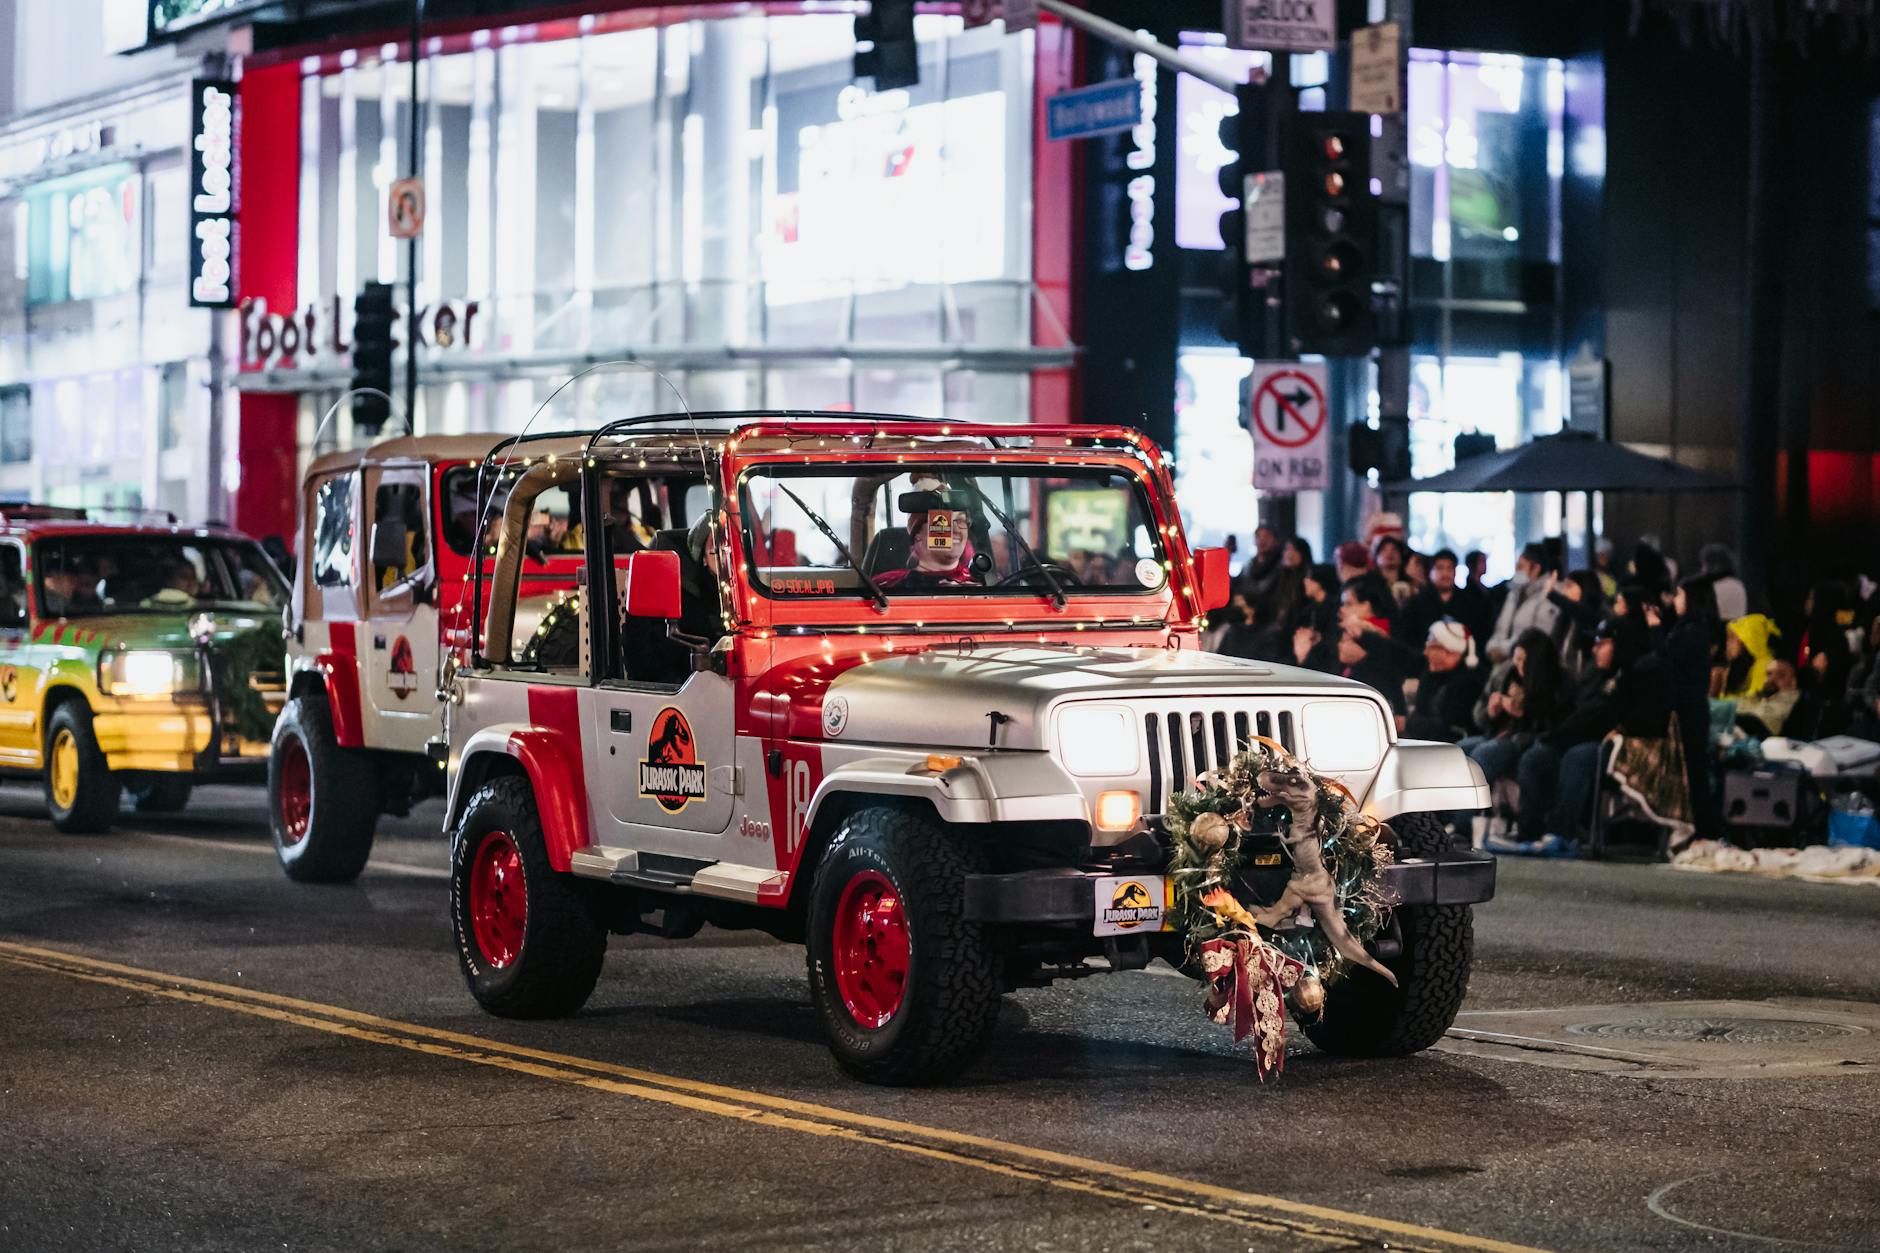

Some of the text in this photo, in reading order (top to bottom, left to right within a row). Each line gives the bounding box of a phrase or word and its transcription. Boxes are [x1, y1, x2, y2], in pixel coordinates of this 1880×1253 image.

[194, 86, 231, 213] Locker
[1258, 457, 1283, 477] ON
[641, 763, 704, 795] JURASSIC PARK
[783, 759, 811, 853] 18
[740, 814, 770, 842] Jeep
[1104, 907, 1158, 923] JURASSIC PARK
